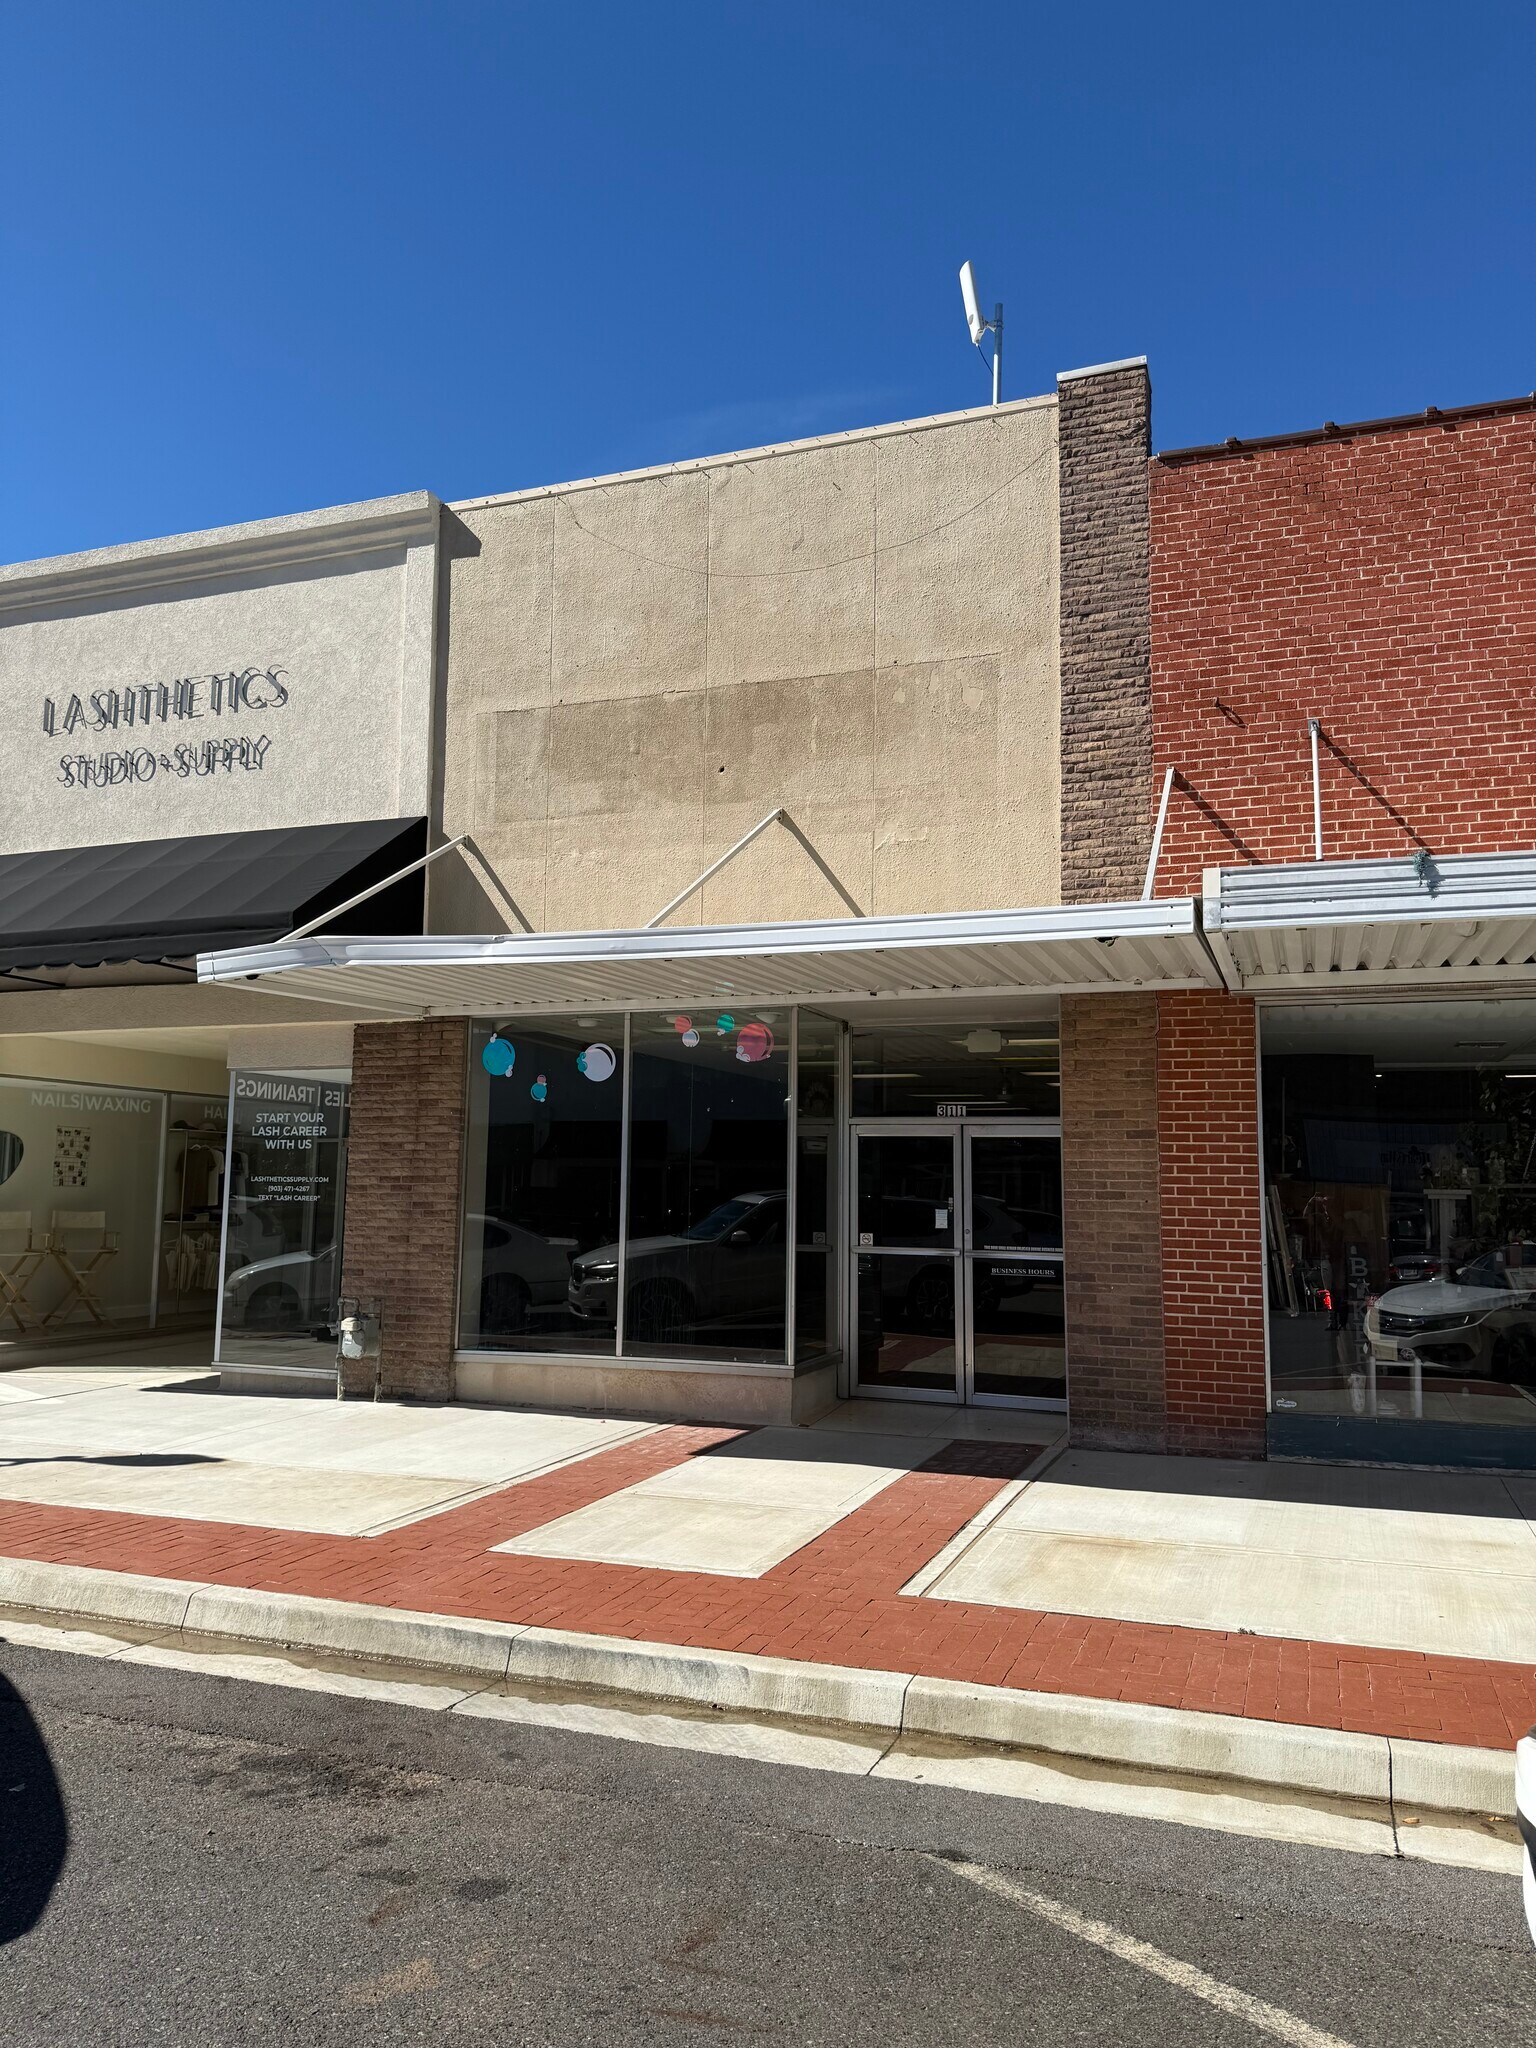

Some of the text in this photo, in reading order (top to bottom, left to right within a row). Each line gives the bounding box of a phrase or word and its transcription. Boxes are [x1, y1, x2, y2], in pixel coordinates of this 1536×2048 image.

[42, 664, 289, 737] LASHTHETICS
[57, 747, 156, 788] STUDIO
[172, 734, 272, 777] SUPPLY
[938, 1105, 965, 1117] 311
[256, 1112, 325, 1123] START YOUR
[251, 1126, 327, 1136] LASH CAREER
[265, 1139, 312, 1150] WITH US
[250, 1175, 330, 1183] LASHTHETICSSUPPLY.COM
[268, 1185, 283, 1193] (903)
[991, 1267, 1056, 1276] BUSINESS HOURS
